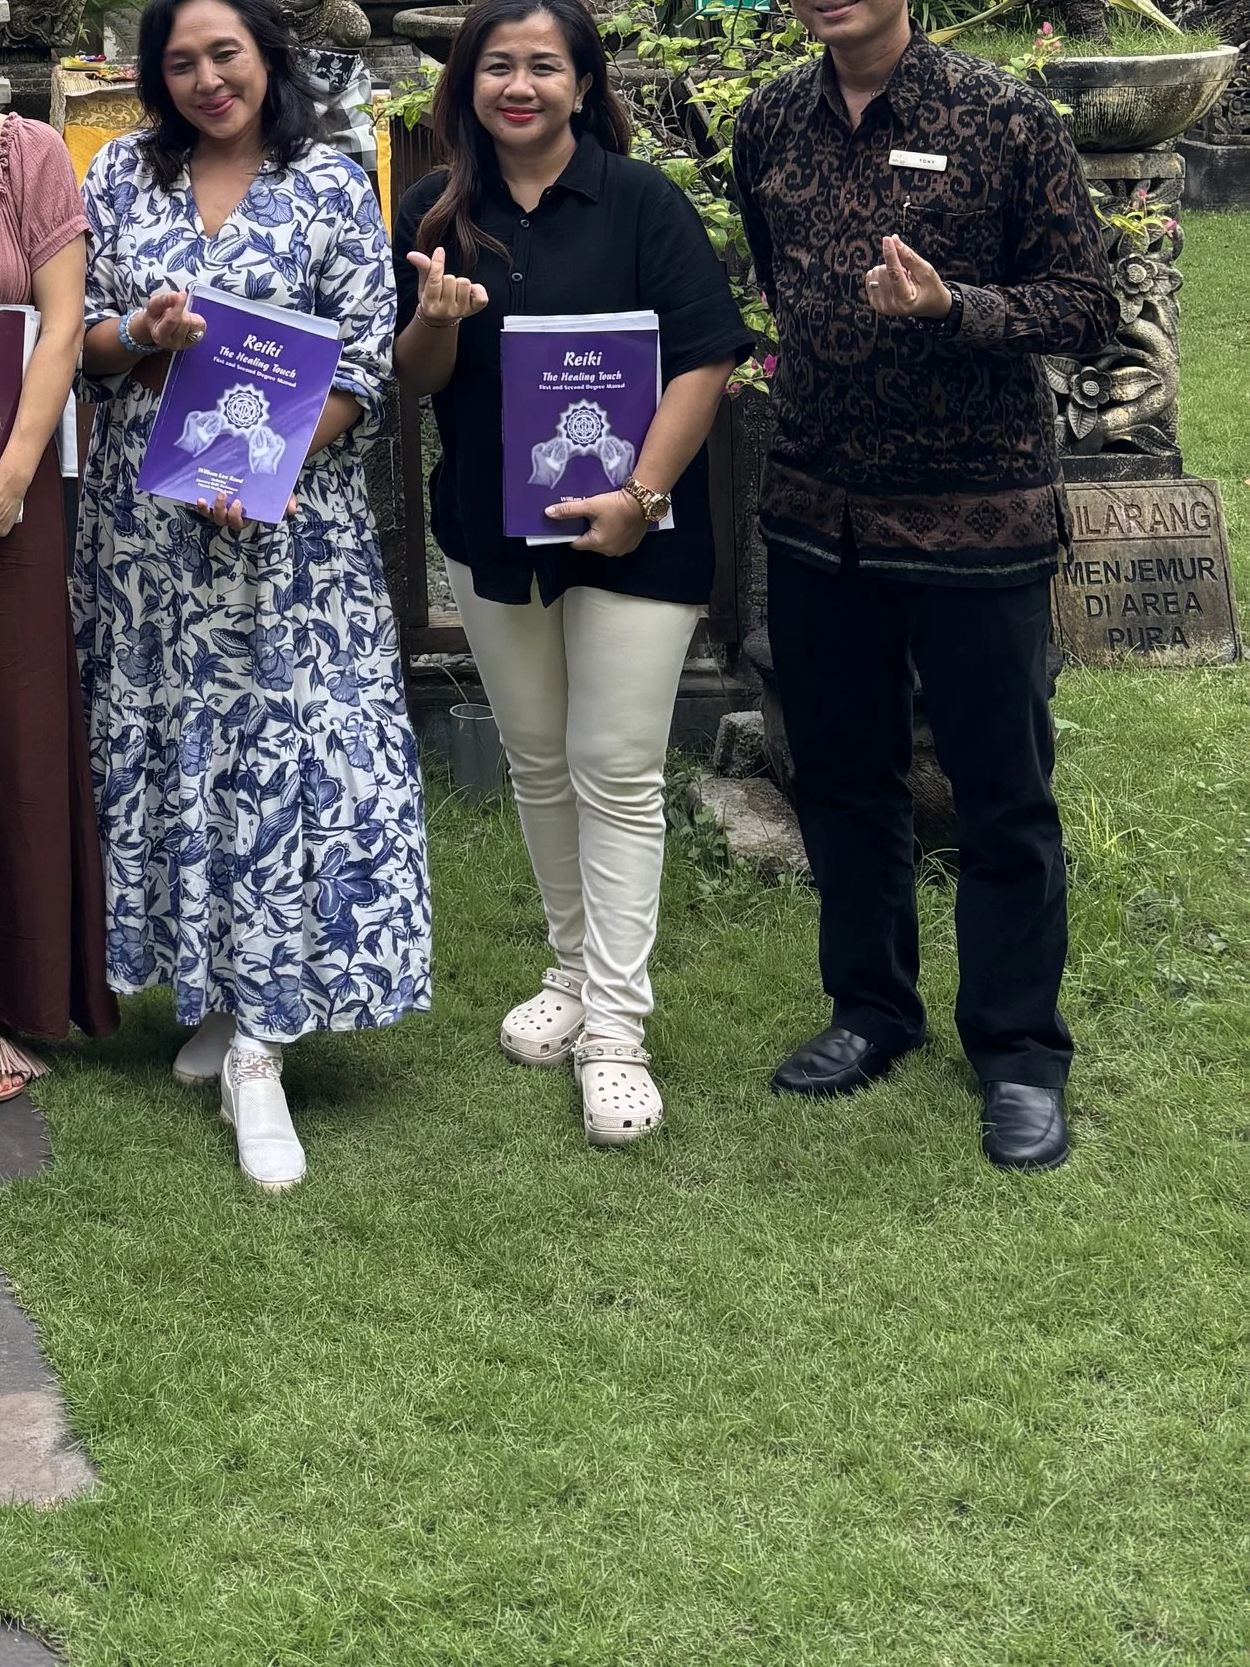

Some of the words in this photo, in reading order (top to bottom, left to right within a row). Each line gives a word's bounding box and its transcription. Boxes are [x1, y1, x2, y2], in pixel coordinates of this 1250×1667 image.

[243, 334, 283, 358] Reiki
[563, 350, 603, 367] Reiki
[219, 345, 235, 358] The
[235, 351, 270, 372] Healing
[272, 363, 297, 378] Touch
[542, 371, 558, 381] The
[560, 371, 596, 383] Healing
[598, 370, 622, 381] Touch
[1073, 500, 1211, 536] ILARANG
[1062, 556, 1218, 586] MENJEMUR
[1085, 594, 1112, 618] DI
[1121, 591, 1205, 618] AREA
[1107, 625, 1190, 652] PURA
